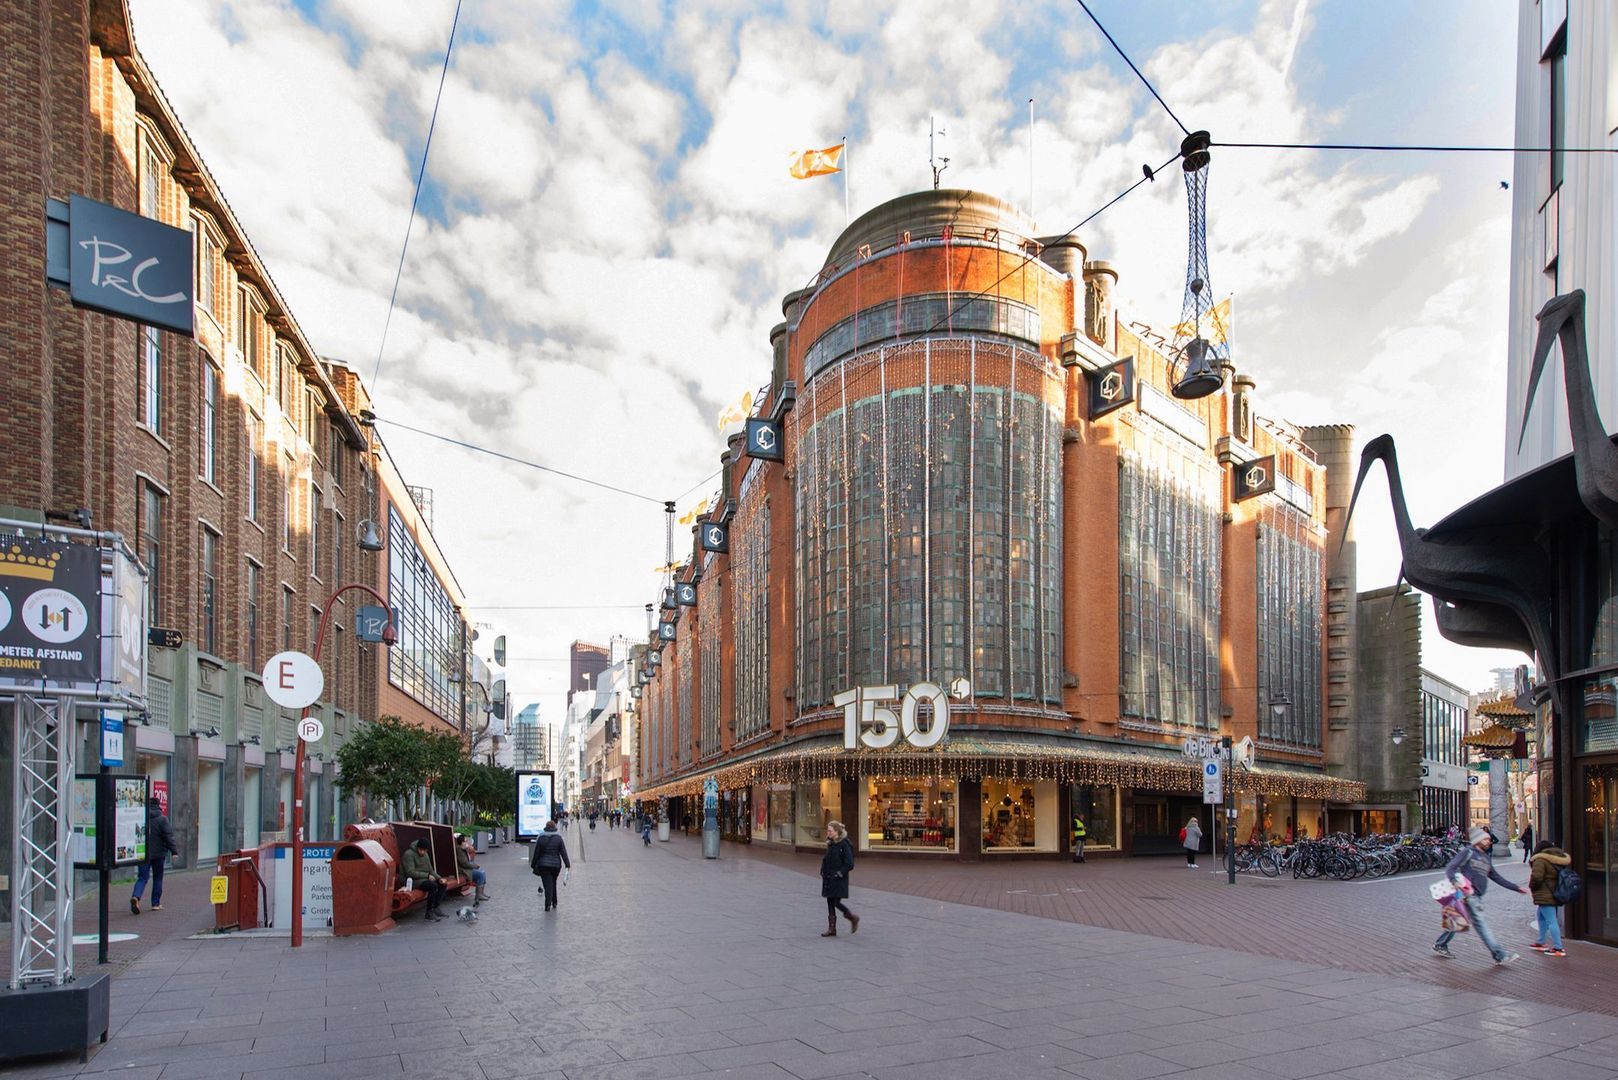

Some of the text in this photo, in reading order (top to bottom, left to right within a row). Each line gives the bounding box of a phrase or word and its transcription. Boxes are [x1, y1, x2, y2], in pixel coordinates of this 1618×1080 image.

[79, 235, 187, 304] P&C
[0, 645, 83, 661] METER AFSTAND
[279, 661, 295, 689] E
[832, 681, 950, 750] 150
[1184, 736, 1198, 756] de
[311, 884, 331, 892] Alleen
[310, 907, 331, 915] Grote
